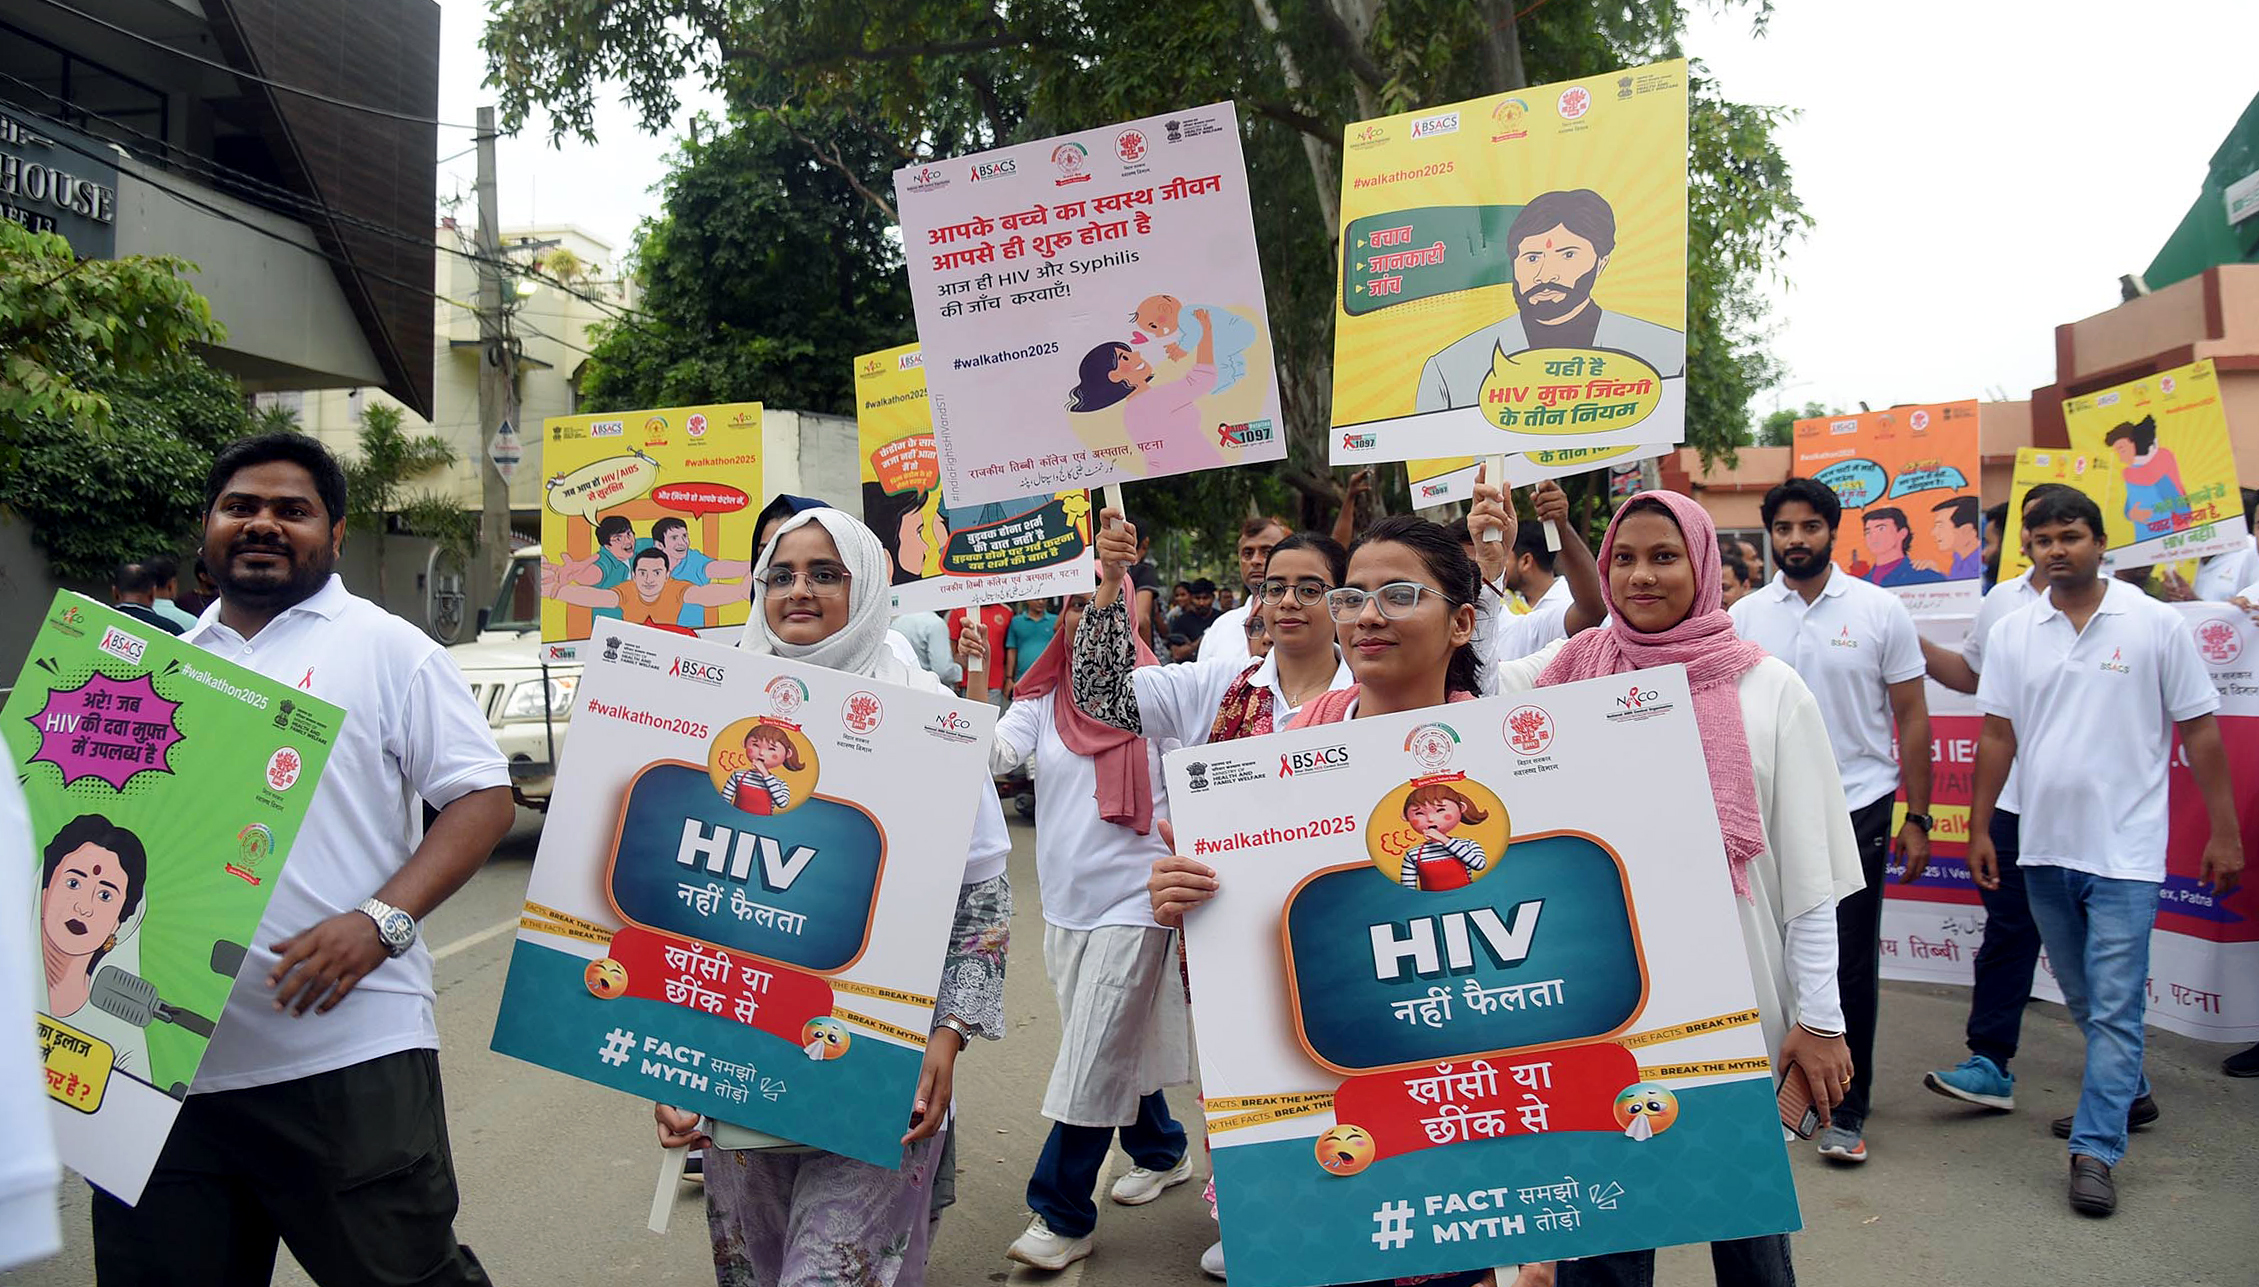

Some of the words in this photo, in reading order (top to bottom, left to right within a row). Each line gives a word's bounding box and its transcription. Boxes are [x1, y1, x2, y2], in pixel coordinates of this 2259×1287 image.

[1422, 116, 1457, 132] BSACS
[913, 168, 941, 184] NACO
[980, 160, 1016, 176] BSACS
[1353, 161, 1454, 189] #walkathon2025
[0, 152, 114, 225] HOUSE
[928, 216, 994, 246] आपके
[999, 204, 1048, 231] बच्चे
[1053, 200, 1087, 221] का
[1091, 188, 1154, 214] स्वस्थ
[1159, 174, 1222, 202] जीवन
[932, 242, 995, 272] आपसे
[1000, 235, 1025, 259] ही
[1077, 218, 1129, 245] होता
[1133, 211, 1152, 234] है
[1369, 225, 1413, 249] बचाव
[1368, 242, 1446, 274] जानकारी
[938, 279, 971, 297] आज
[975, 273, 993, 291] ही
[998, 269, 1030, 287] HIV
[1036, 261, 1064, 279] और
[1069, 249, 1140, 275] Syphilis
[1368, 274, 1403, 297] जांच
[940, 300, 963, 319] की
[967, 293, 1001, 314] जाँच
[954, 341, 1060, 371] #walkathon2025
[1545, 356, 1584, 377] यही
[1588, 357, 1606, 376] है
[865, 388, 928, 409] #walkathon2025
[1488, 386, 1530, 404] HIV
[1536, 384, 1582, 407] मुक्त
[1585, 378, 1653, 400] जिंदगी
[1499, 407, 1520, 427] के
[1523, 405, 1566, 427] तीन
[1571, 401, 1639, 425] नियम
[599, 423, 622, 434] BSACS
[1240, 428, 1271, 444] 1097
[935, 393, 960, 503] #IndiaFightsHIVandSTI
[1355, 439, 1375, 448] 1097
[685, 455, 756, 467] #walkathon2025
[968, 463, 1005, 480] राजकीय
[1009, 457, 1035, 472] तिब्बी
[1039, 453, 1068, 468] कॉलेज
[1072, 450, 1086, 462] एवं
[1092, 445, 1133, 459] अस्पताल,
[1136, 439, 1165, 452] पटना
[601, 464, 639, 484] HIV/AIDS
[998, 524, 1022, 536] होना
[1023, 514, 1044, 530] शर्म
[973, 542, 988, 553] की
[991, 540, 1010, 549] बात
[1012, 531, 1035, 546] नहीं
[1035, 529, 1045, 541] है
[1008, 546, 1023, 556] पर
[1043, 532, 1074, 548] करना
[2163, 534, 2184, 549] HIV
[968, 562, 984, 570] यह
[1028, 551, 1049, 562] बात
[1050, 547, 1059, 557] है
[1058, 568, 1080, 579] पटना
[111, 634, 144, 658] BSACS
[1830, 638, 1858, 648] BSACS
[682, 660, 724, 682] BSACS
[2100, 662, 2130, 675] BSACS
[181, 663, 269, 710] #walkathon2025
[1617, 687, 1658, 709] NACO
[82, 689, 112, 710] अरे!
[116, 695, 143, 713] जब
[45, 713, 81, 733] HIV
[81, 712, 102, 733] की
[103, 718, 131, 736] दवा
[588, 698, 709, 741] #walkathon2025
[936, 712, 970, 730] NACO
[71, 736, 90, 756] में
[89, 741, 143, 762] उपलब्ध
[144, 743, 157, 764] है
[1293, 747, 1349, 769] BSACS
[1237, 773, 1266, 782] WELFARE
[1194, 815, 1356, 856] #walkathon2025
[677, 818, 817, 890] HIV
[677, 882, 724, 916] नहीं
[730, 886, 807, 937] फैलता
[2179, 889, 2213, 908] Patna
[549, 911, 575, 925] BREAK
[576, 919, 592, 929] THE
[568, 929, 594, 940] BREAK
[596, 934, 611, 943] THE
[1369, 900, 1543, 980] HIV
[1909, 935, 1961, 963] तिब्बी
[664, 942, 731, 986] खाँसी
[741, 966, 773, 996] या
[665, 977, 726, 1016] छींक
[734, 991, 760, 1026] से
[879, 989, 909, 1001] BREAK
[911, 995, 928, 1004] THE
[1390, 986, 1453, 1028] नहीं
[1462, 978, 1565, 1016] फैलता
[2169, 982, 2222, 1015] पटना
[848, 1013, 876, 1027] BREAK
[879, 1023, 895, 1034] THE
[897, 1029, 927, 1044] MYTHS.
[1628, 1035, 1648, 1046] THE
[1686, 1018, 1724, 1033] BREAK
[1727, 1013, 1749, 1025] THE
[54, 1029, 93, 1057] इलाज
[599, 1027, 636, 1068] #
[644, 1037, 705, 1067] FACT
[710, 1058, 757, 1083] समझो
[1661, 1066, 1700, 1076] BREAK
[1703, 1064, 1725, 1072] THE
[1728, 1060, 1770, 1070] MYTHS.
[640, 1058, 708, 1091] MYTH
[714, 1079, 749, 1104] तोड़ो
[1404, 1060, 1499, 1105] खाँसी
[1509, 1061, 1553, 1091] या
[1219, 1119, 1239, 1128] THE
[1274, 1105, 1310, 1117] BREAK
[1312, 1099, 1334, 1110] THE
[1242, 1099, 1278, 1107] BREAK
[1419, 1104, 1506, 1144] छींक
[1516, 1093, 1550, 1134] से
[1372, 1199, 1415, 1250] #
[1425, 1187, 1509, 1216] FACT
[1518, 1177, 1580, 1206] समझो
[1433, 1214, 1527, 1243] MYTH
[1533, 1204, 1581, 1236] तोड़ो
